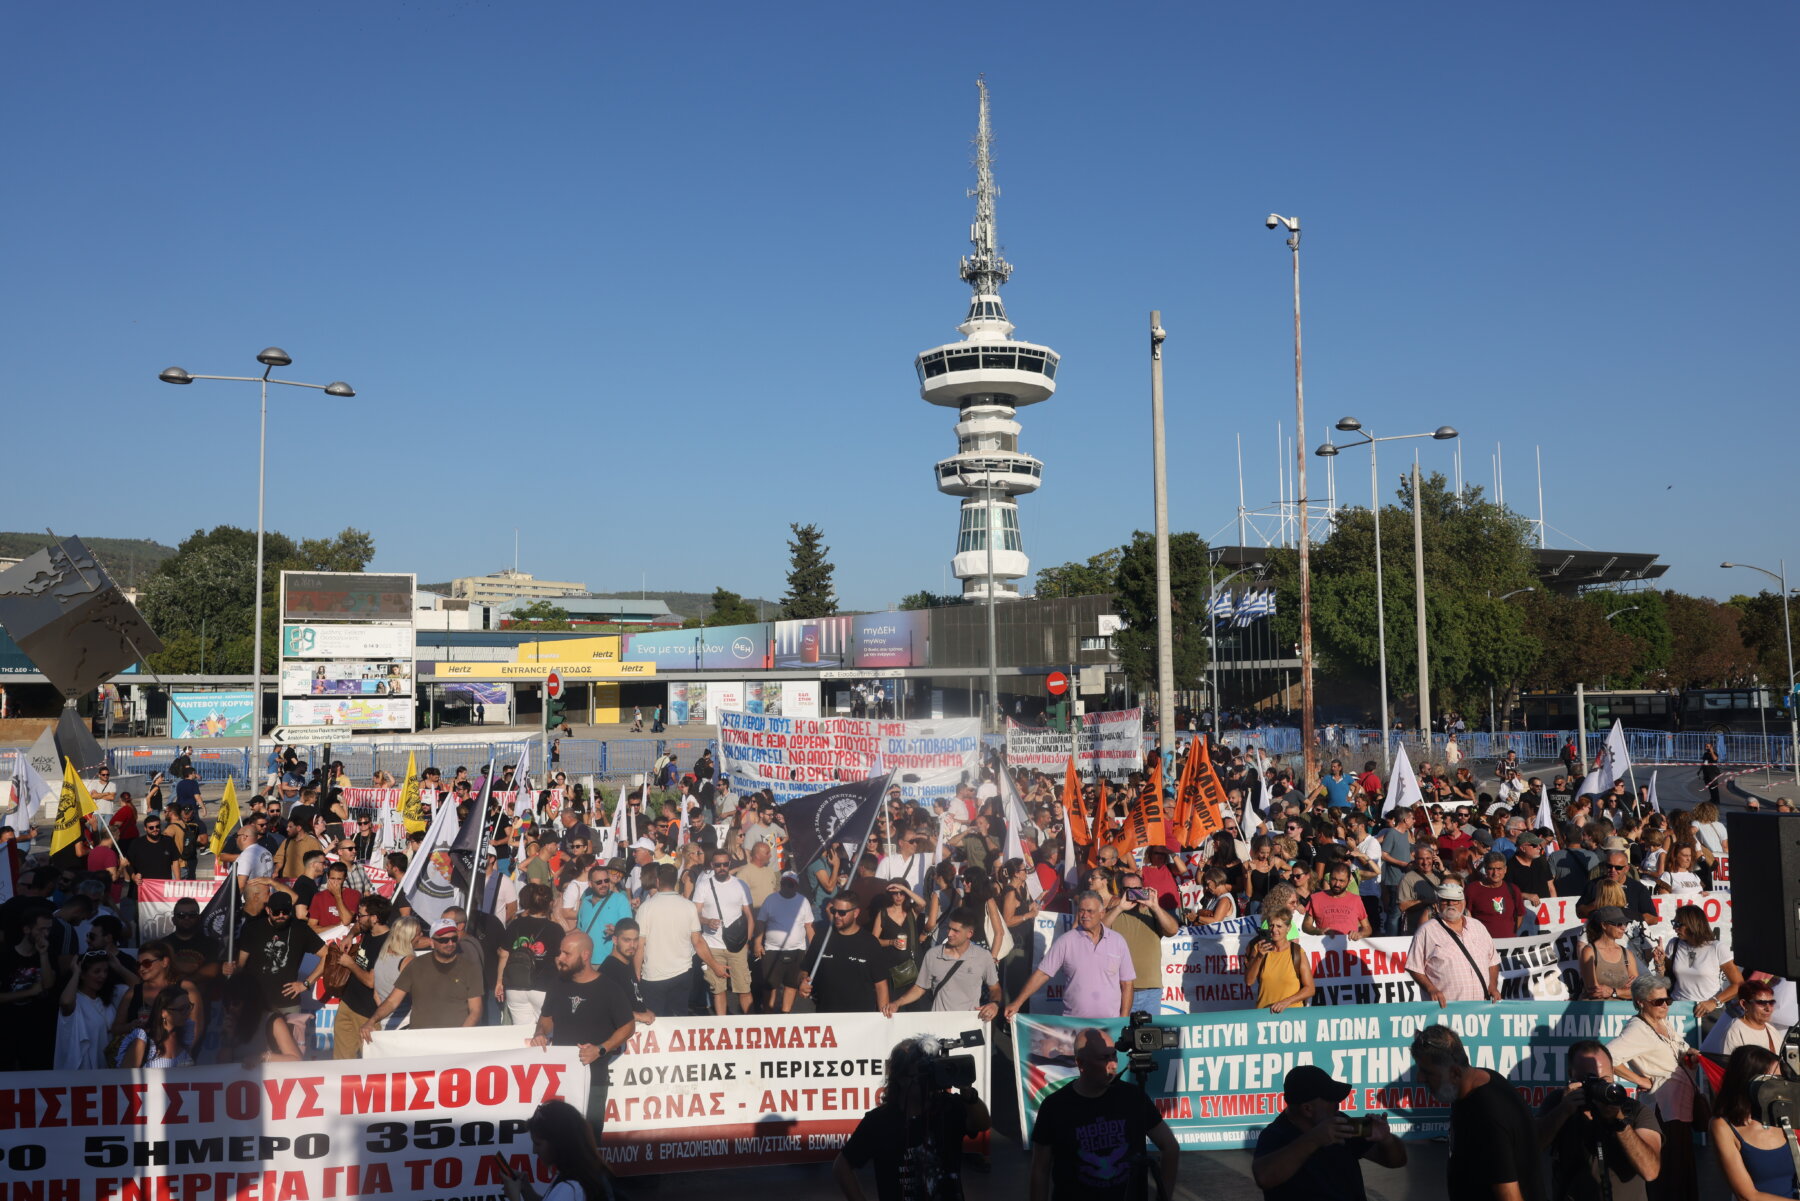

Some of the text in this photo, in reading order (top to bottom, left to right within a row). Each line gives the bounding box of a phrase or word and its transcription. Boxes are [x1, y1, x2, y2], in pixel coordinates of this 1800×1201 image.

[863, 626, 896, 636] myΔΕΗ
[592, 651, 613, 659] Hertz
[636, 644, 656, 654] Ένα
[659, 646, 671, 655] με
[673, 646, 685, 654] το
[734, 642, 751, 653] ΔΕΗ
[448, 665, 472, 673] Hertz
[501, 666, 547, 674] ENTRANCE
[621, 665, 644, 673] Hertz
[769, 718, 791, 734] ΤΟΥΣ
[808, 720, 818, 734] ΟΙ
[825, 719, 871, 736] ΣΠΟΥΔΕΣ
[722, 729, 749, 745] ΠΤΥΧΙΑ
[752, 733, 763, 748] ΜΕ
[790, 735, 830, 750] ΔΩΡΕΑΝ
[834, 735, 881, 753] ΣΠΟΥΔΕΣ
[888, 738, 906, 754] ΟΧΙ
[789, 750, 805, 765] ΝΑ
[807, 750, 860, 768] ΑΠΟΣΥΡΘΕΙ
[759, 764, 773, 779] ΓΙΑ
[775, 765, 791, 780] ΤΙΣ
[1143, 783, 1161, 823] ΟΛΟΙ
[164, 880, 216, 898] ΝΟΜΟΣ
[1172, 941, 1200, 956] μας
[1166, 963, 1202, 974] στους
[1311, 948, 1407, 979] ΔΩΡΕΑΝ
[1196, 983, 1254, 1001] ΠΑΙΔΕΙΑ
[1312, 980, 1415, 1006] ΑΥΞΗΣΕΙΣ
[624, 1025, 838, 1055] ΝΑ ΔΙΚΑΙΩΜΑΤΑ
[1178, 1022, 1248, 1049] ΛΕΓΓΥΗ
[1257, 1020, 1307, 1046] ΣΤΟΝ
[1316, 1017, 1381, 1042] ΑΓΩΝΑ
[1389, 1014, 1427, 1038] ΤΟΥ
[1500, 1014, 1539, 1038] ΤΗΣ
[623, 1062, 737, 1086] ΔΟΥΛΕΙΑΣ
[1331, 1046, 1412, 1085] ΣΤΗΝ
[161, 1076, 325, 1125] ΣΤΟΥΣ
[340, 1063, 567, 1115] ΜΙΣΘΟΥΣ
[604, 1092, 726, 1123] ΑΓΩΝΑΣ
[1153, 1096, 1194, 1120] ΜΙΑ
[84, 1133, 330, 1168] 5ΗΜΕΡΟ
[366, 1117, 528, 1153] 35ΩΡ
[1185, 1132, 1222, 1143] ΠΑΡΟΙΚΙΑ
[1223, 1130, 1262, 1143] ΘΕΣΣΑΛΟΝ
[1389, 1123, 1416, 1133] ΟΝΙΚΗΣ
[597, 1146, 640, 1164] ΤΑΛΛΟΥ
[644, 1144, 654, 1161] &
[659, 1139, 729, 1160] ΕΡΓΑΖΟΜΕΝΩΝ
[734, 1134, 802, 1155] ΝΑΥΠ/ΣΤΙΚΗΣ
[96, 1170, 310, 1201] ΕΝΕΡΓΕΙΑ
[322, 1162, 394, 1199] ΓΙΑ
[404, 1156, 463, 1191] ΤΟ
